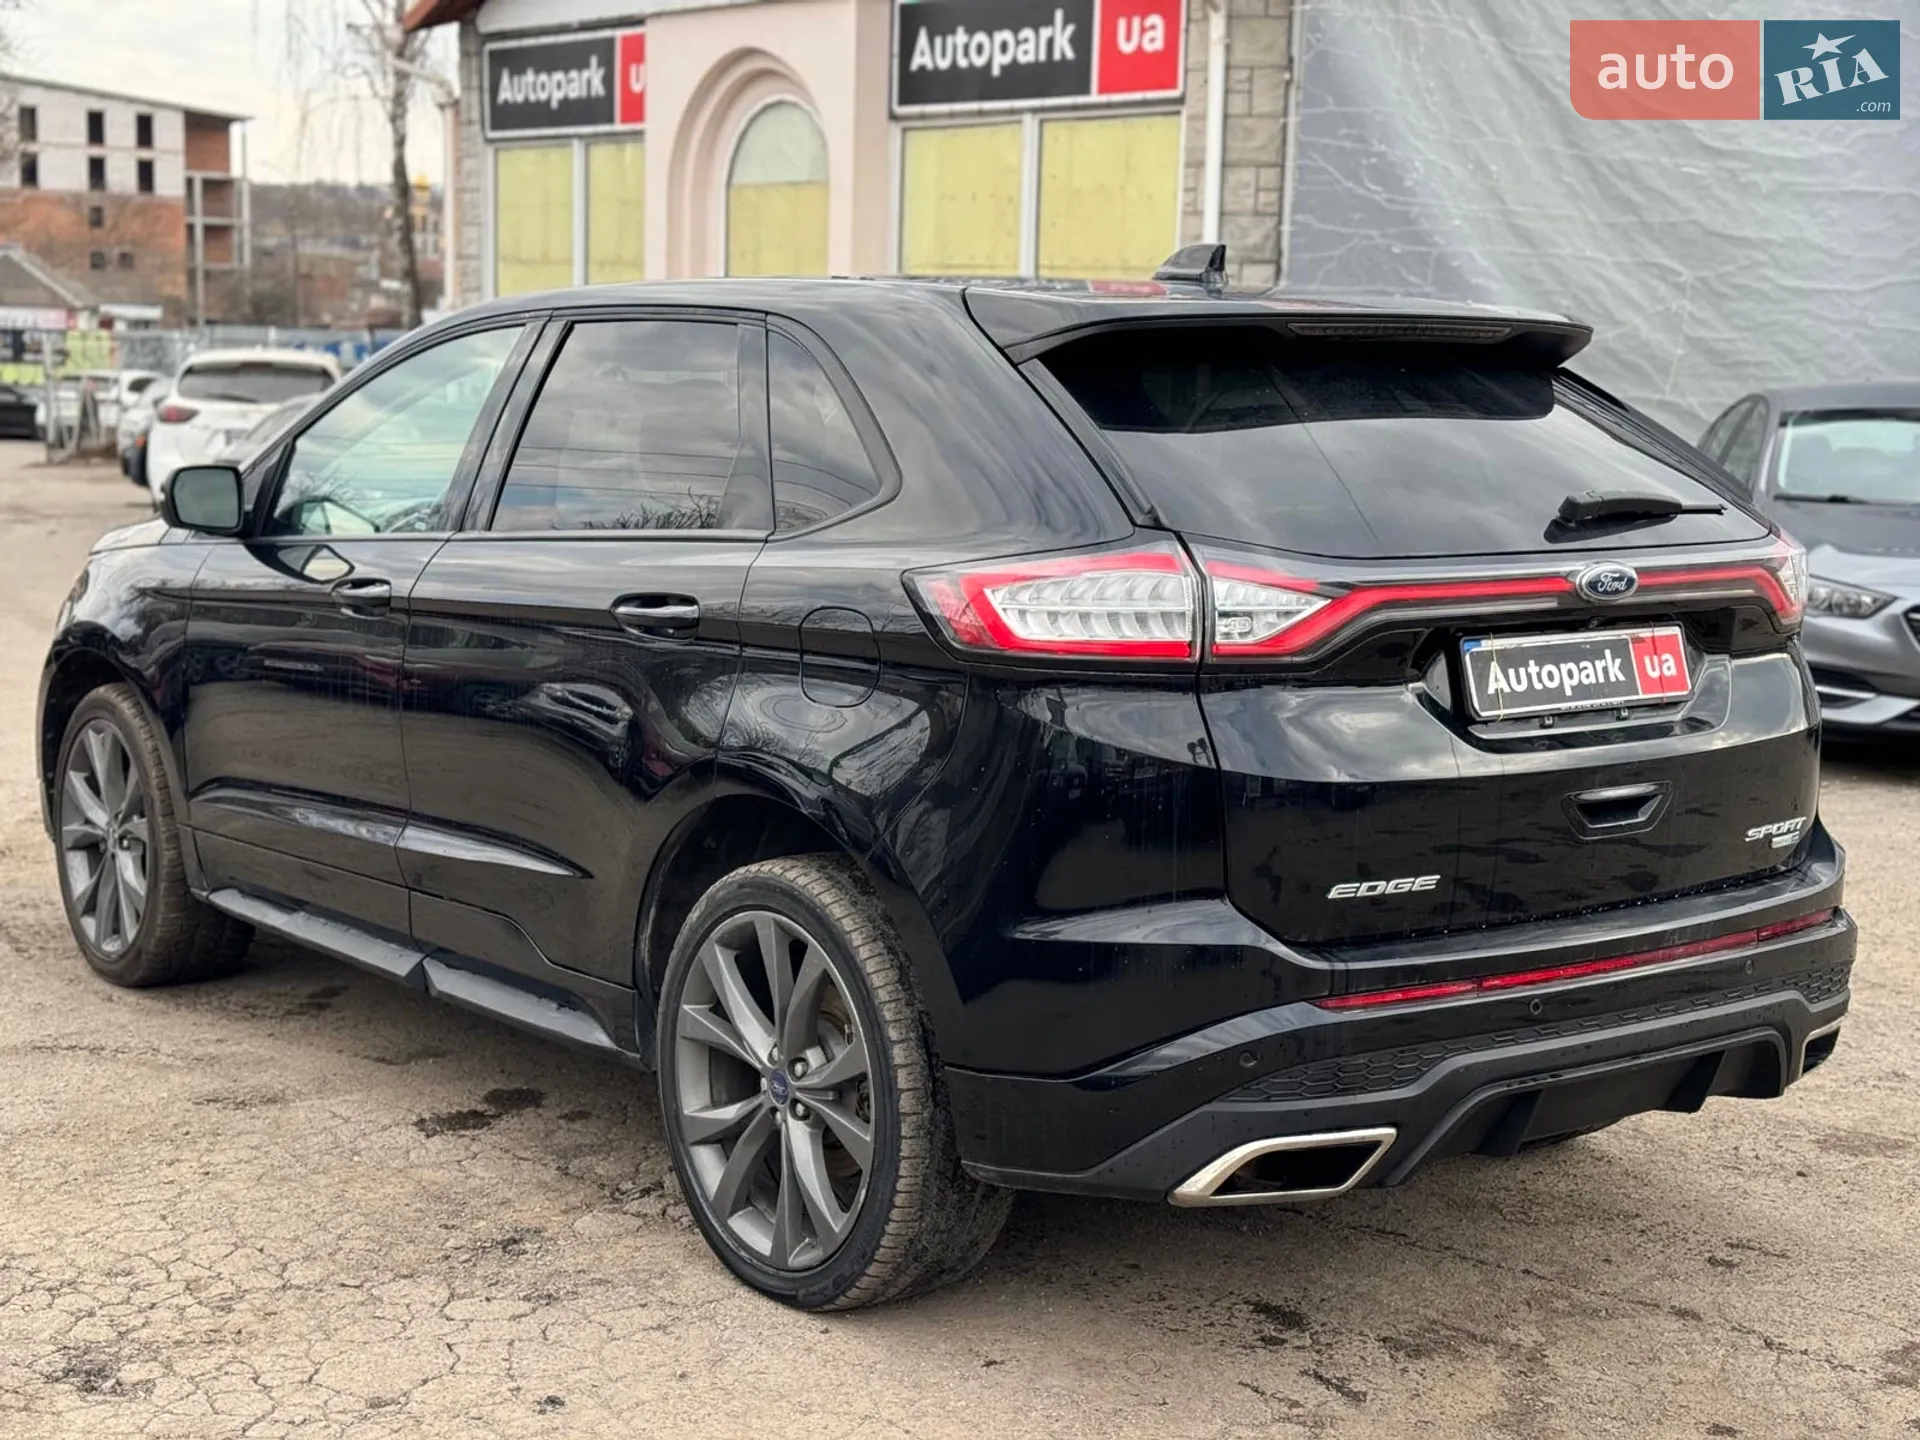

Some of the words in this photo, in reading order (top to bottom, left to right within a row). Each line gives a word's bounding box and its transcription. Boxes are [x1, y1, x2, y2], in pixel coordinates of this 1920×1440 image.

[909, 8, 1076, 77] Autopark
[1116, 13, 1165, 54] ua
[497, 54, 606, 110] Autopark
[1597, 572, 1627, 592] Ford
[1487, 649, 1626, 696] Autopark
[1644, 652, 1677, 678] ua
[1745, 816, 1807, 842] SPORT
[1327, 875, 1441, 899] EDGE
